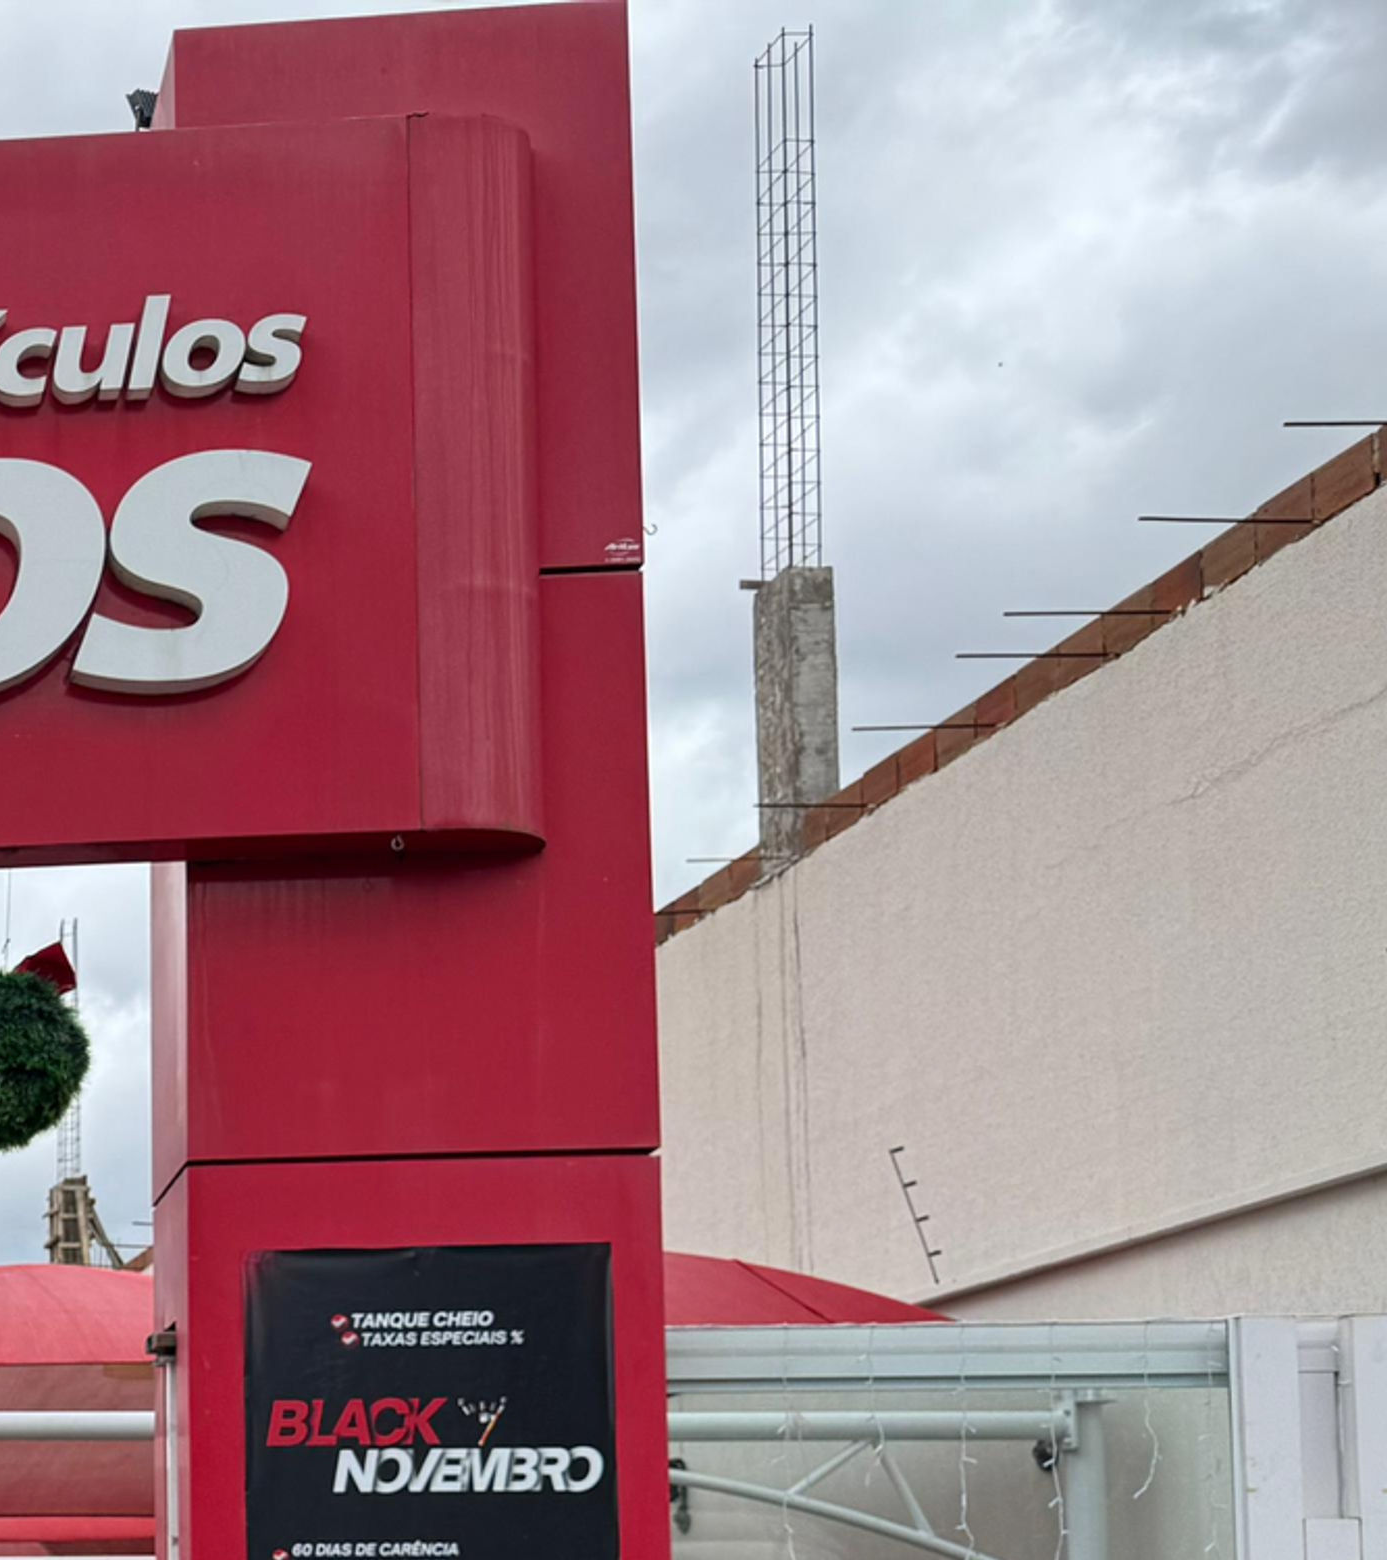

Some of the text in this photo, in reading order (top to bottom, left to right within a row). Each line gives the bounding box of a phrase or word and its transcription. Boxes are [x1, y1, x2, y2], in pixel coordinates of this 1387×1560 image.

[351, 1310, 494, 1329] TANQUE CHEIO
[361, 1329, 525, 1347] TAXAS ESPECIAIS %
[266, 1397, 448, 1447] BLACK
[332, 1446, 604, 1494] NOVEMBRO
[292, 1539, 459, 1557] 60 DIAS DE CARÊNCIA
